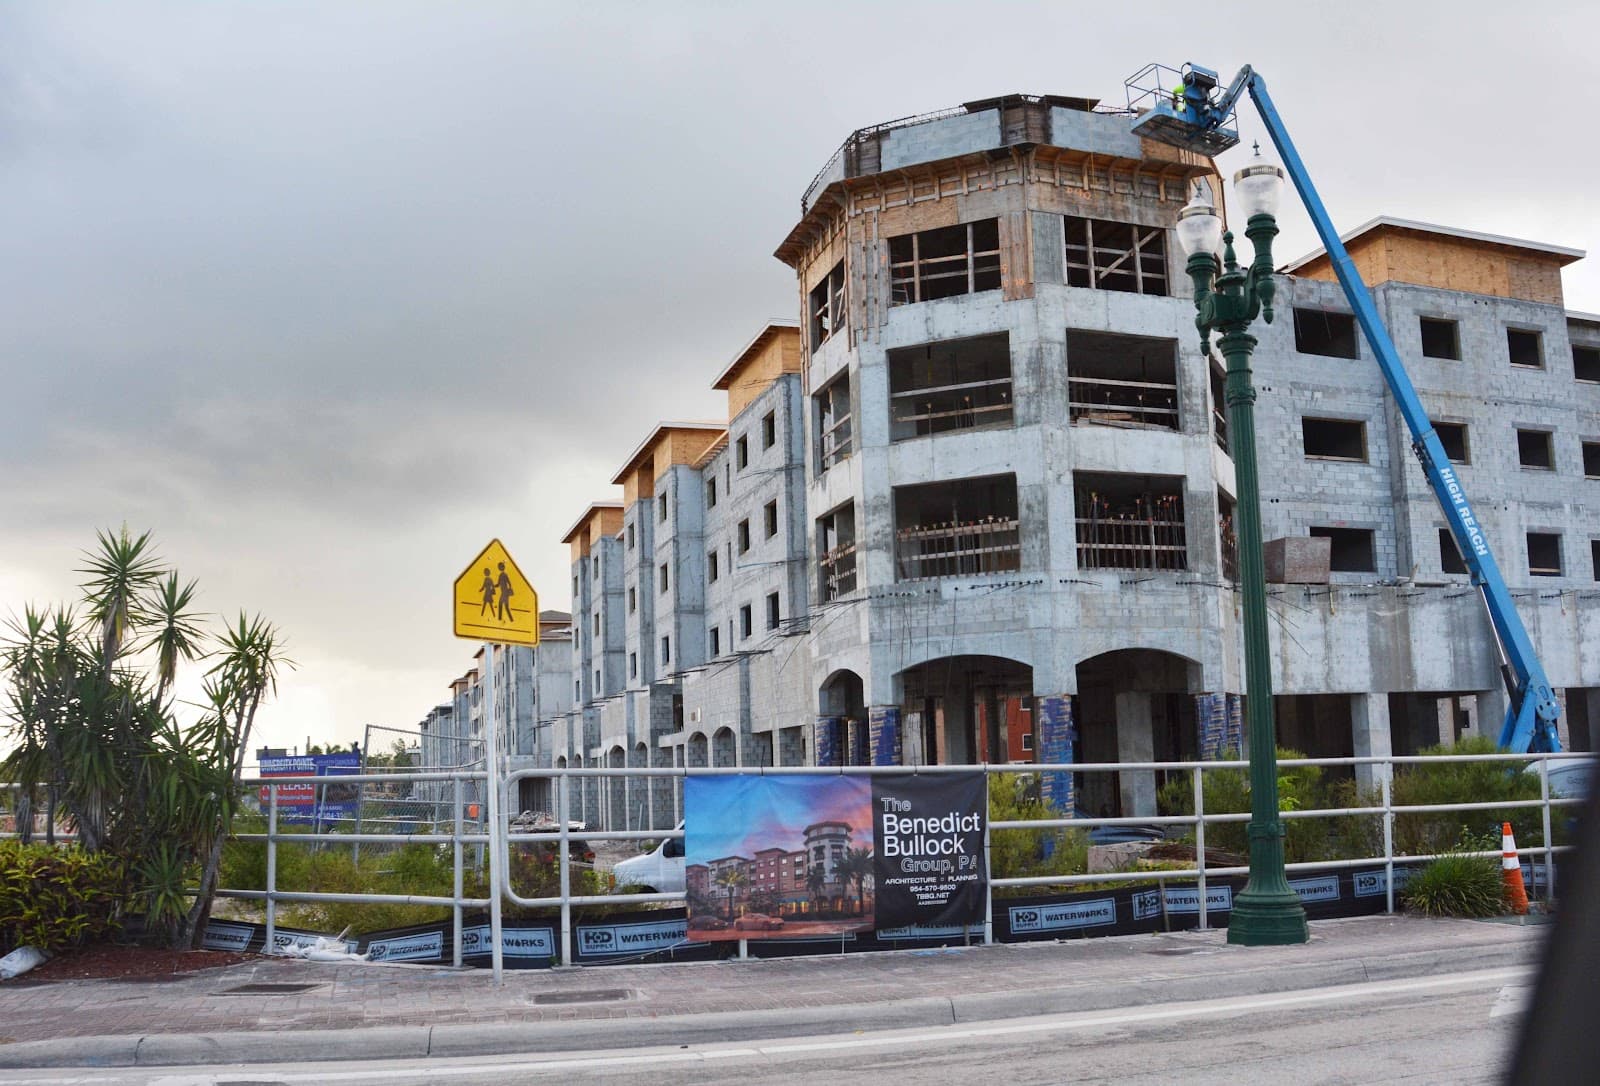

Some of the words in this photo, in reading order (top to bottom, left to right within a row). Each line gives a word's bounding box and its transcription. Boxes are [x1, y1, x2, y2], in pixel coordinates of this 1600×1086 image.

[1440, 468, 1465, 504] HIGH
[1458, 506, 1488, 556] REACH
[881, 797, 912, 812] The
[882, 812, 980, 834] Benedict
[883, 833, 965, 857] Bullock
[900, 857, 955, 875] Group,
[885, 876, 937, 885] ARCHITECTURE
[915, 892, 951, 900] TBBG.NET
[1295, 884, 1334, 896] ERWORKS
[1045, 908, 1109, 922] WATERWORKS
[484, 938, 545, 948] WWORKS
[621, 930, 688, 943] WATERWOR
